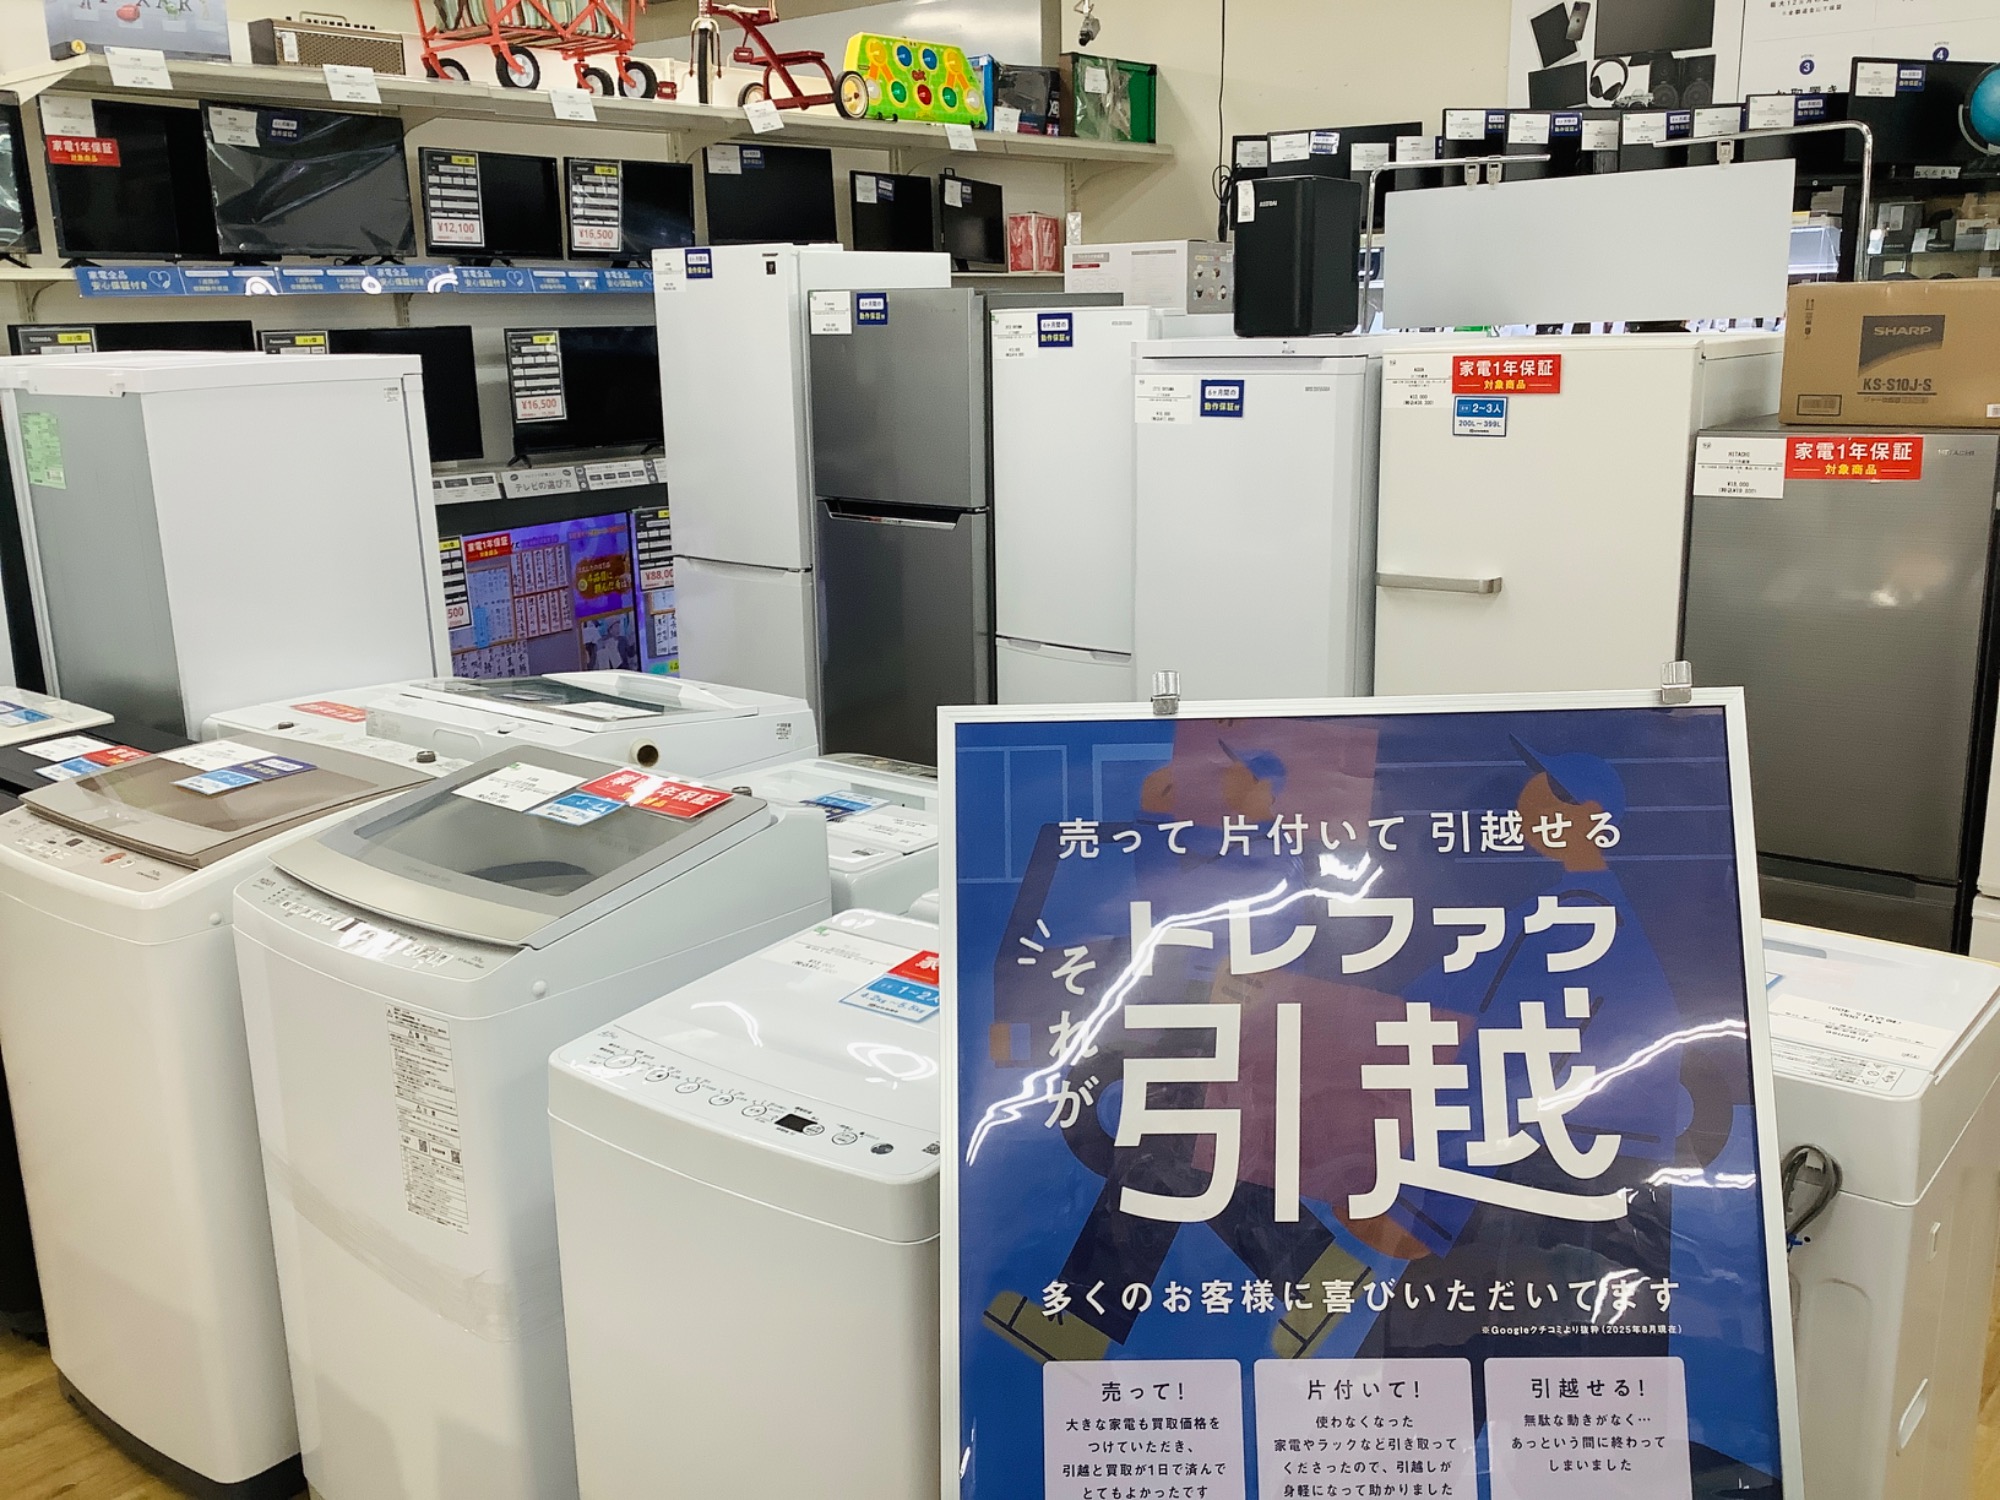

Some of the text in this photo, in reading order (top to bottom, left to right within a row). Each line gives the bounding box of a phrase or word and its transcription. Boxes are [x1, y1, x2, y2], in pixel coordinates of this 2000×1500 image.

[52, 140, 113, 154] 家電1年保証
[437, 221, 475, 234] ¥12,100
[578, 227, 614, 240] ¥16,500
[1874, 325, 1932, 336] SHARP
[1459, 359, 1554, 377] 家電1年保証
[1483, 379, 1526, 390] 対象商品
[1863, 378, 1932, 391] KS-S10J-S
[521, 398, 557, 410] ¥16,500
[1795, 441, 1914, 461] 家電1年保証
[1825, 463, 1878, 476] 対象商品
[515, 478, 573, 494] テレビの選び方
[1058, 810, 1622, 859] 売って 片付いて 引越せる
[1129, 896, 1618, 977] トレファク
[1112, 988, 1630, 1223] 引越
[1041, 1278, 1680, 1316] 多くのお客様に喜びいただいてます
[1101, 1381, 1184, 1402] 売って!
[1307, 1379, 1420, 1400] 片付いて!
[1530, 1377, 1646, 1399] 引越せる!
[1065, 1416, 1220, 1432] 大きな家電も買取価格を
[1315, 1415, 1414, 1429] 使わなくなった
[1088, 1439, 1194, 1454] つけていただき、
[1273, 1437, 1458, 1452] 家電やラックなど引き取って
[1511, 1435, 1666, 1450] あっという間に終わって
[1062, 1462, 1226, 1478] 引越と買取が1日で済んで
[1283, 1460, 1452, 1475] くださったので、引越しが
[1548, 1458, 1632, 1472] しまいました
[1082, 1486, 1208, 1500] とてもよかったです
[1283, 1482, 1453, 1498] 身軽になって助かりました
